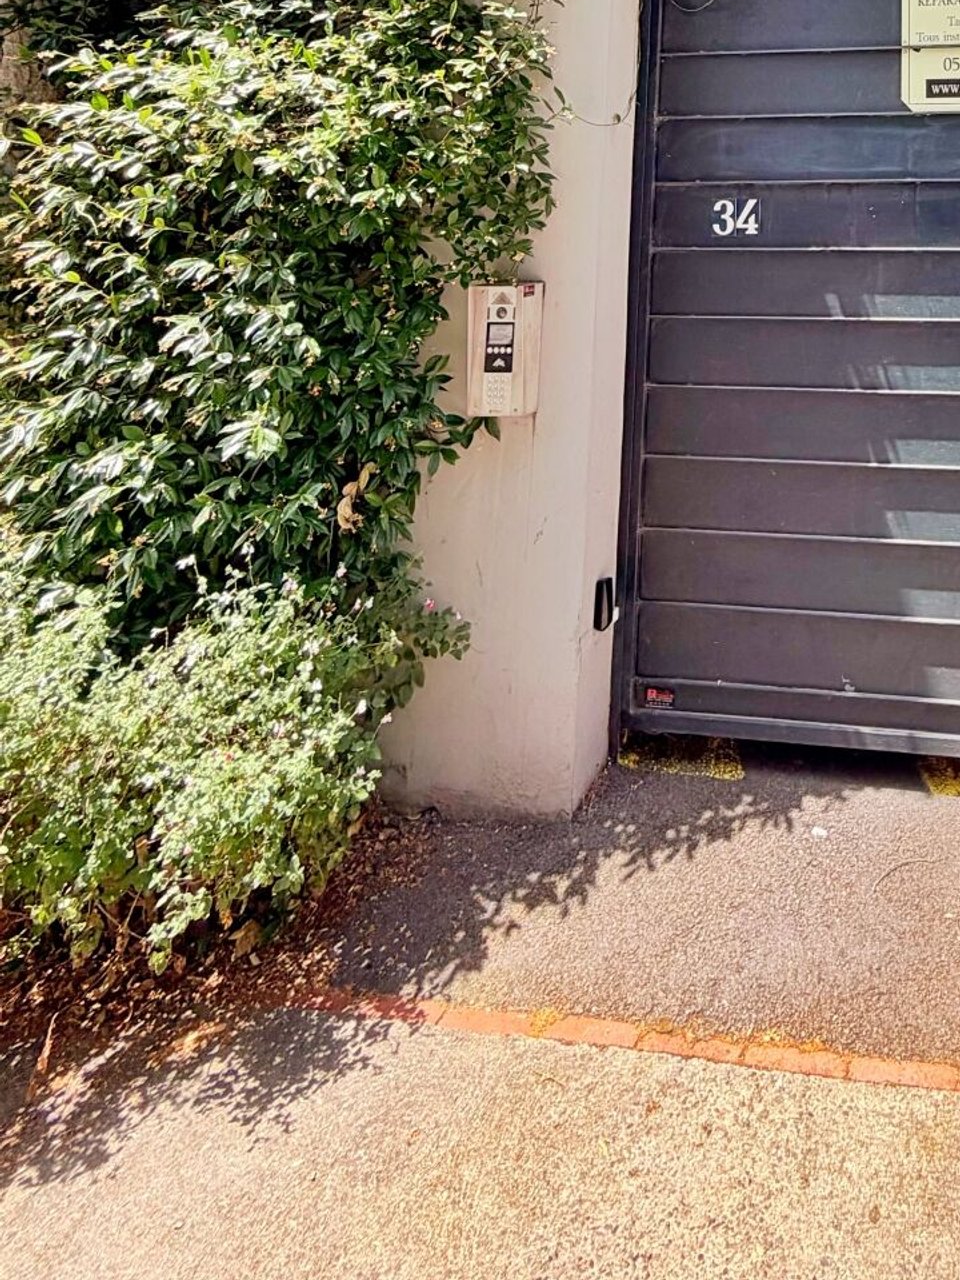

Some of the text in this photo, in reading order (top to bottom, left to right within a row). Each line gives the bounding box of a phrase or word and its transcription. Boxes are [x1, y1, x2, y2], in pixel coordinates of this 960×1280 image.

[916, 31, 940, 43] Tous
[943, 57, 960, 71] 05
[712, 198, 759, 236] 34
